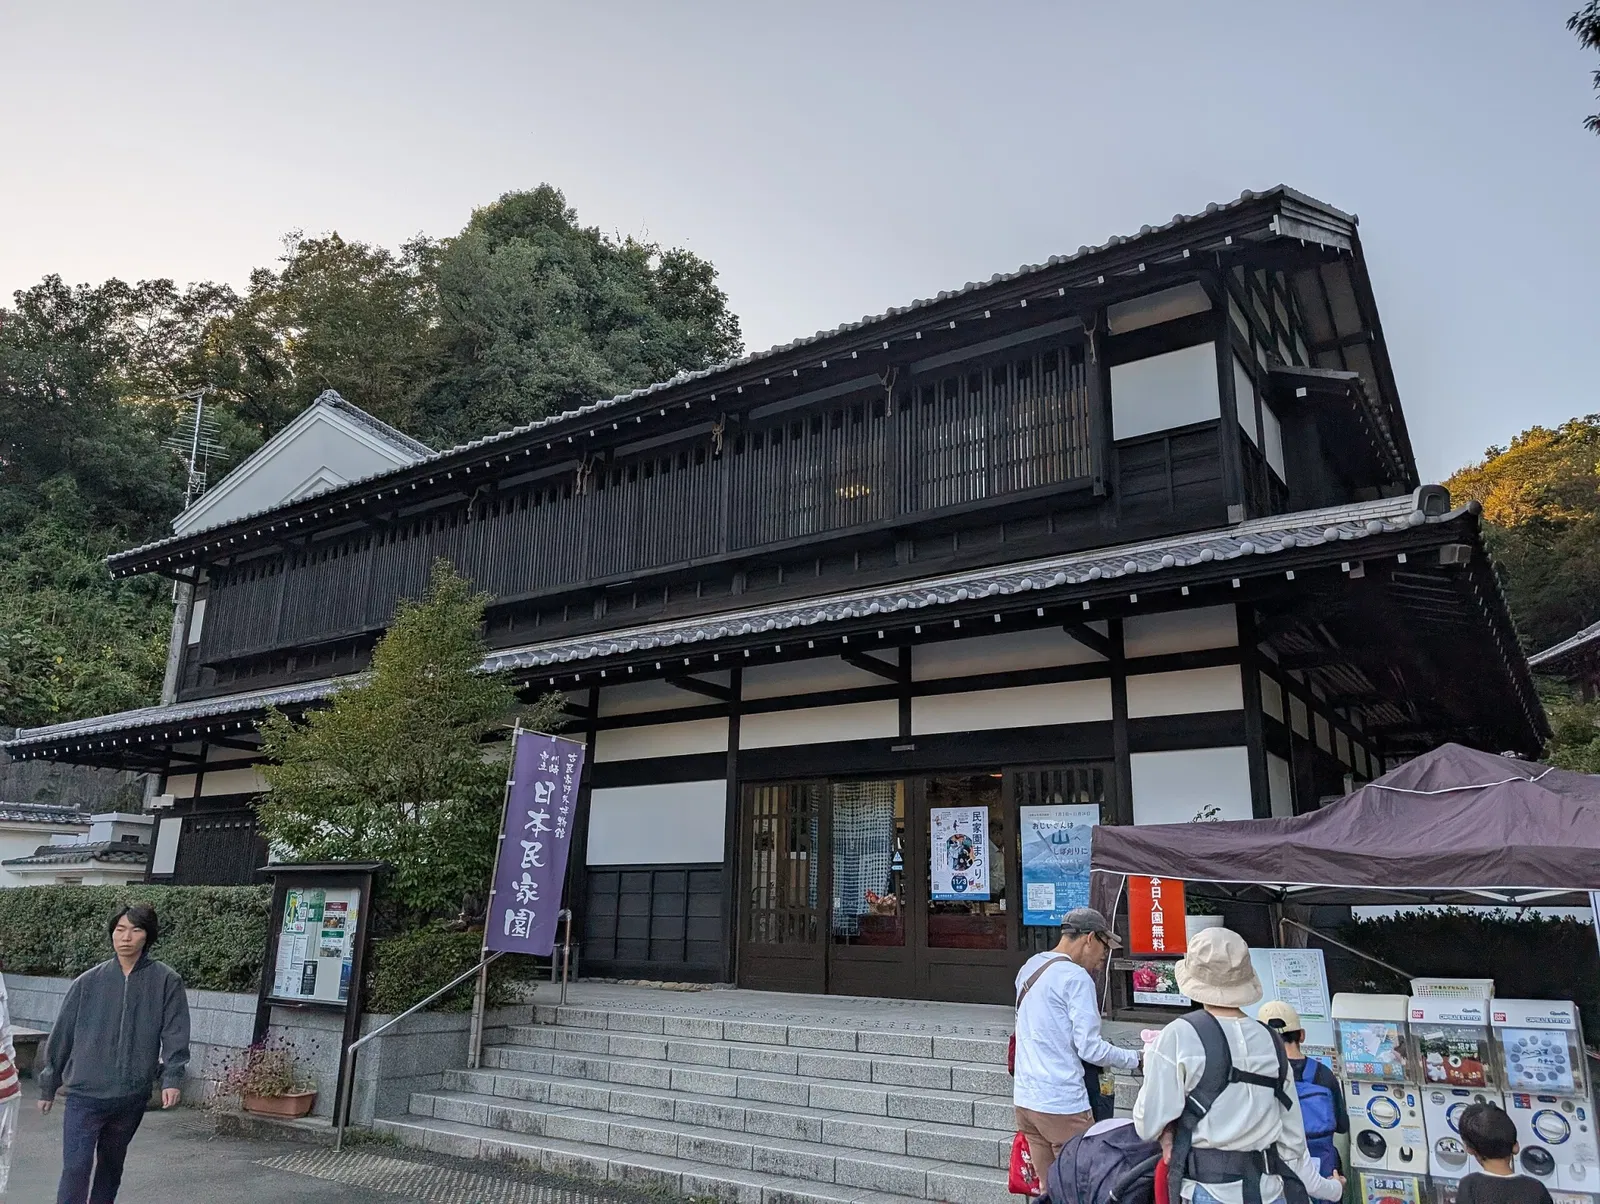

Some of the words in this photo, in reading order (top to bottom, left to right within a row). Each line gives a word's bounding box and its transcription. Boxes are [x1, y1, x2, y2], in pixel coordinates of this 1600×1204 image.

[503, 780, 557, 940] 日本民家園
[972, 811, 983, 880] 民家園まつり
[1032, 821, 1074, 830] おじいさんは
[1053, 847, 1089, 855] しば刈りに
[1149, 876, 1166, 952] 本日入園無料
